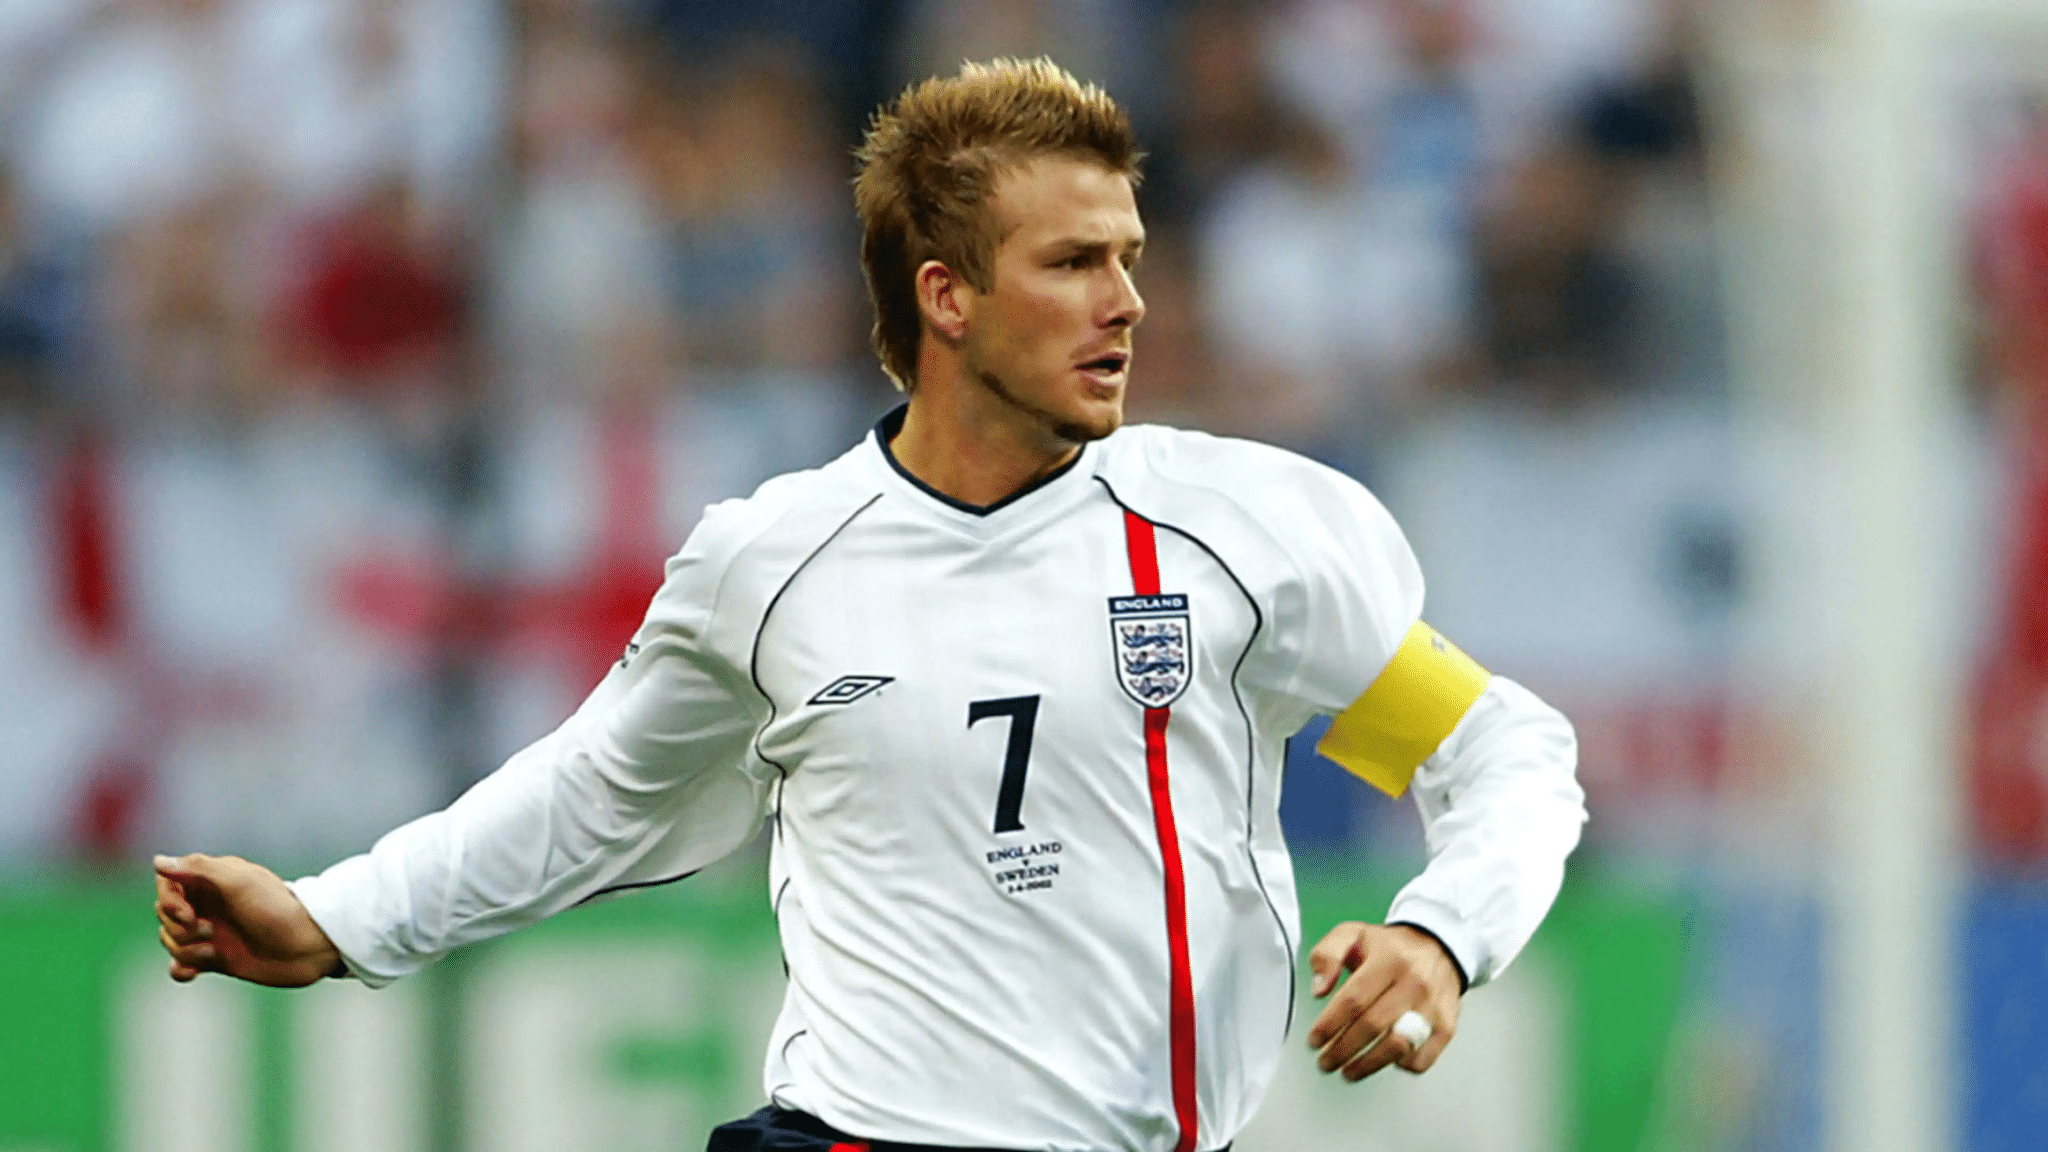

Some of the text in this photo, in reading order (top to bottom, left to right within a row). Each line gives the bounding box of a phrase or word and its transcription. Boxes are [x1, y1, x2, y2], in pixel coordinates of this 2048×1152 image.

[1114, 597, 1184, 611] ENGLAND
[967, 694, 1041, 834] 7
[987, 842, 1062, 863] ENGLAND
[995, 864, 1059, 883] SWEDEN
